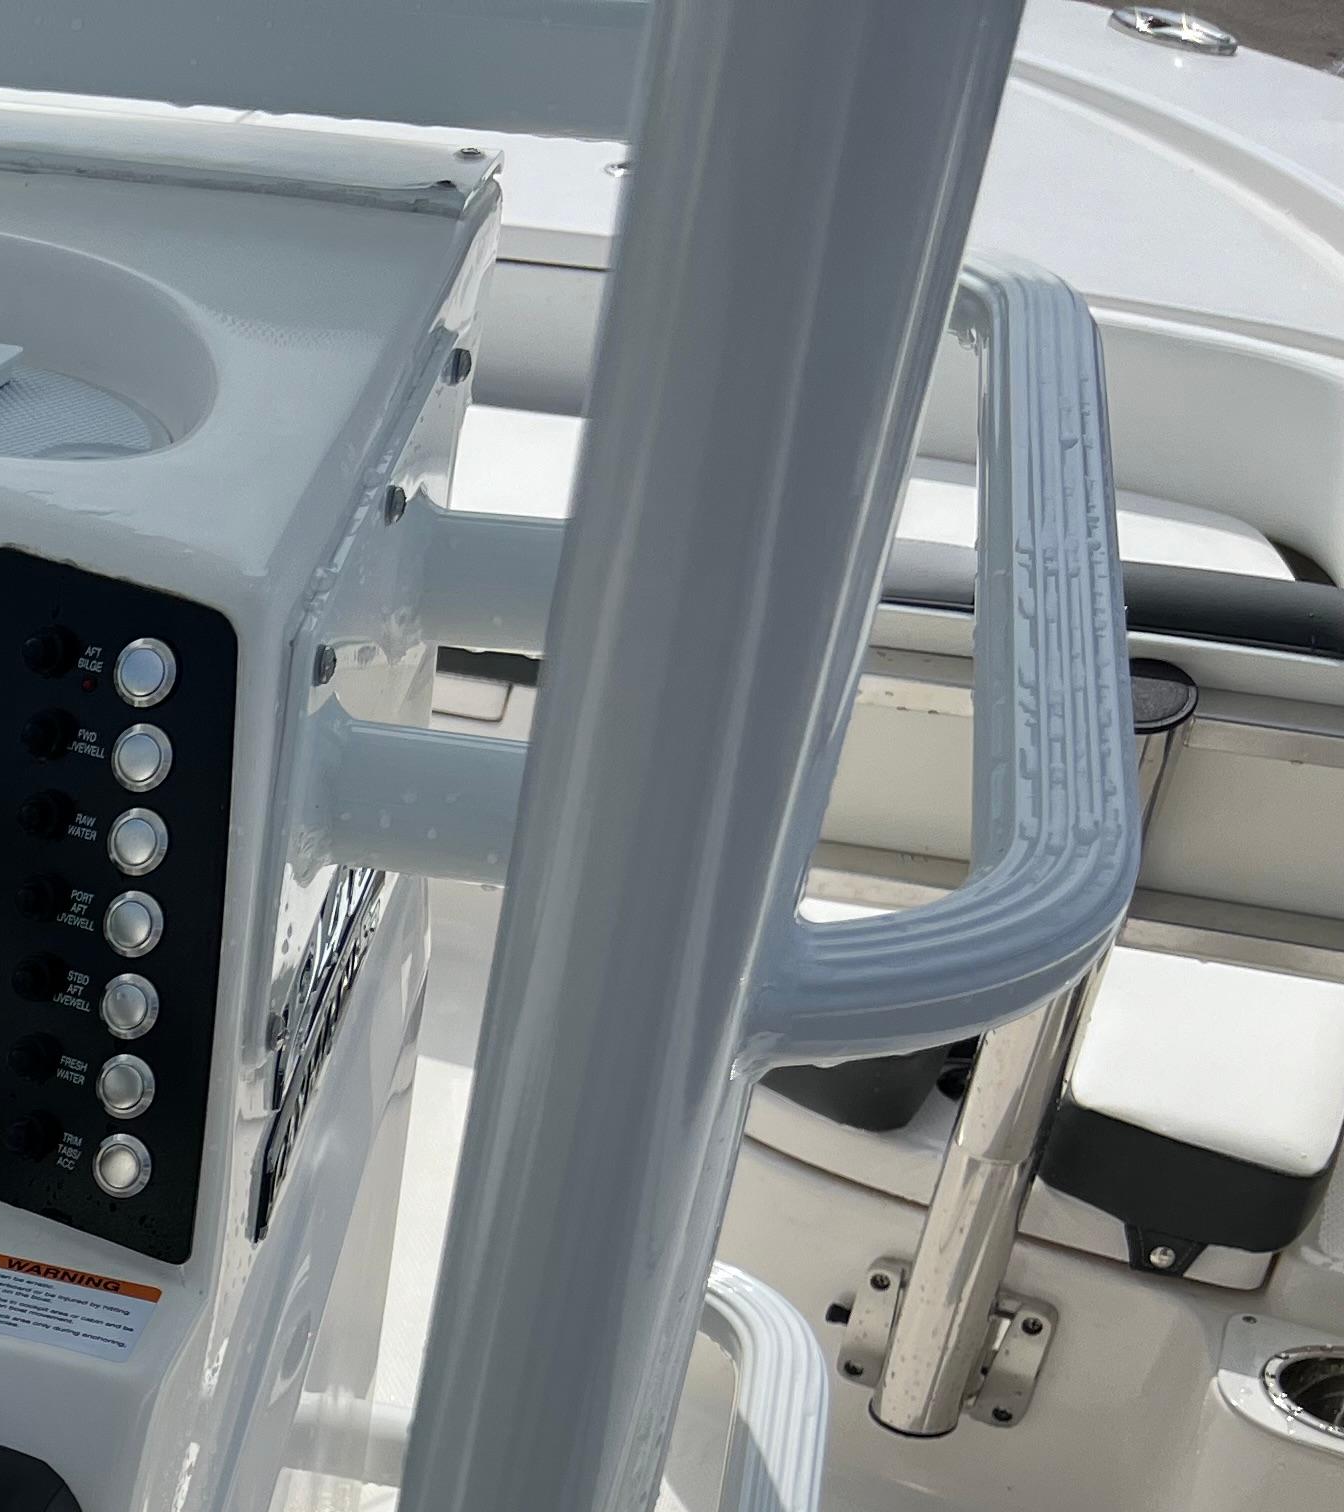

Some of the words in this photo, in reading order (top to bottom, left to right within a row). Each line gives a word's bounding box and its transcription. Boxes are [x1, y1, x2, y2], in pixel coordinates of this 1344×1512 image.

[85, 646, 102, 658] AFT
[78, 658, 104, 673] BILGE
[78, 729, 97, 742] FWD
[75, 813, 97, 827] RAW
[68, 824, 97, 841] WATER
[70, 889, 94, 905] PORT
[70, 902, 87, 916] AFT
[67, 970, 89, 986] STBD
[66, 984, 83, 997] AFT
[59, 1055, 88, 1073] FRESH
[56, 1068, 85, 1086] WATER
[63, 1132, 83, 1147] TRIM
[56, 1157, 75, 1170] ACC
[8, 1258, 121, 1292] WARNING
